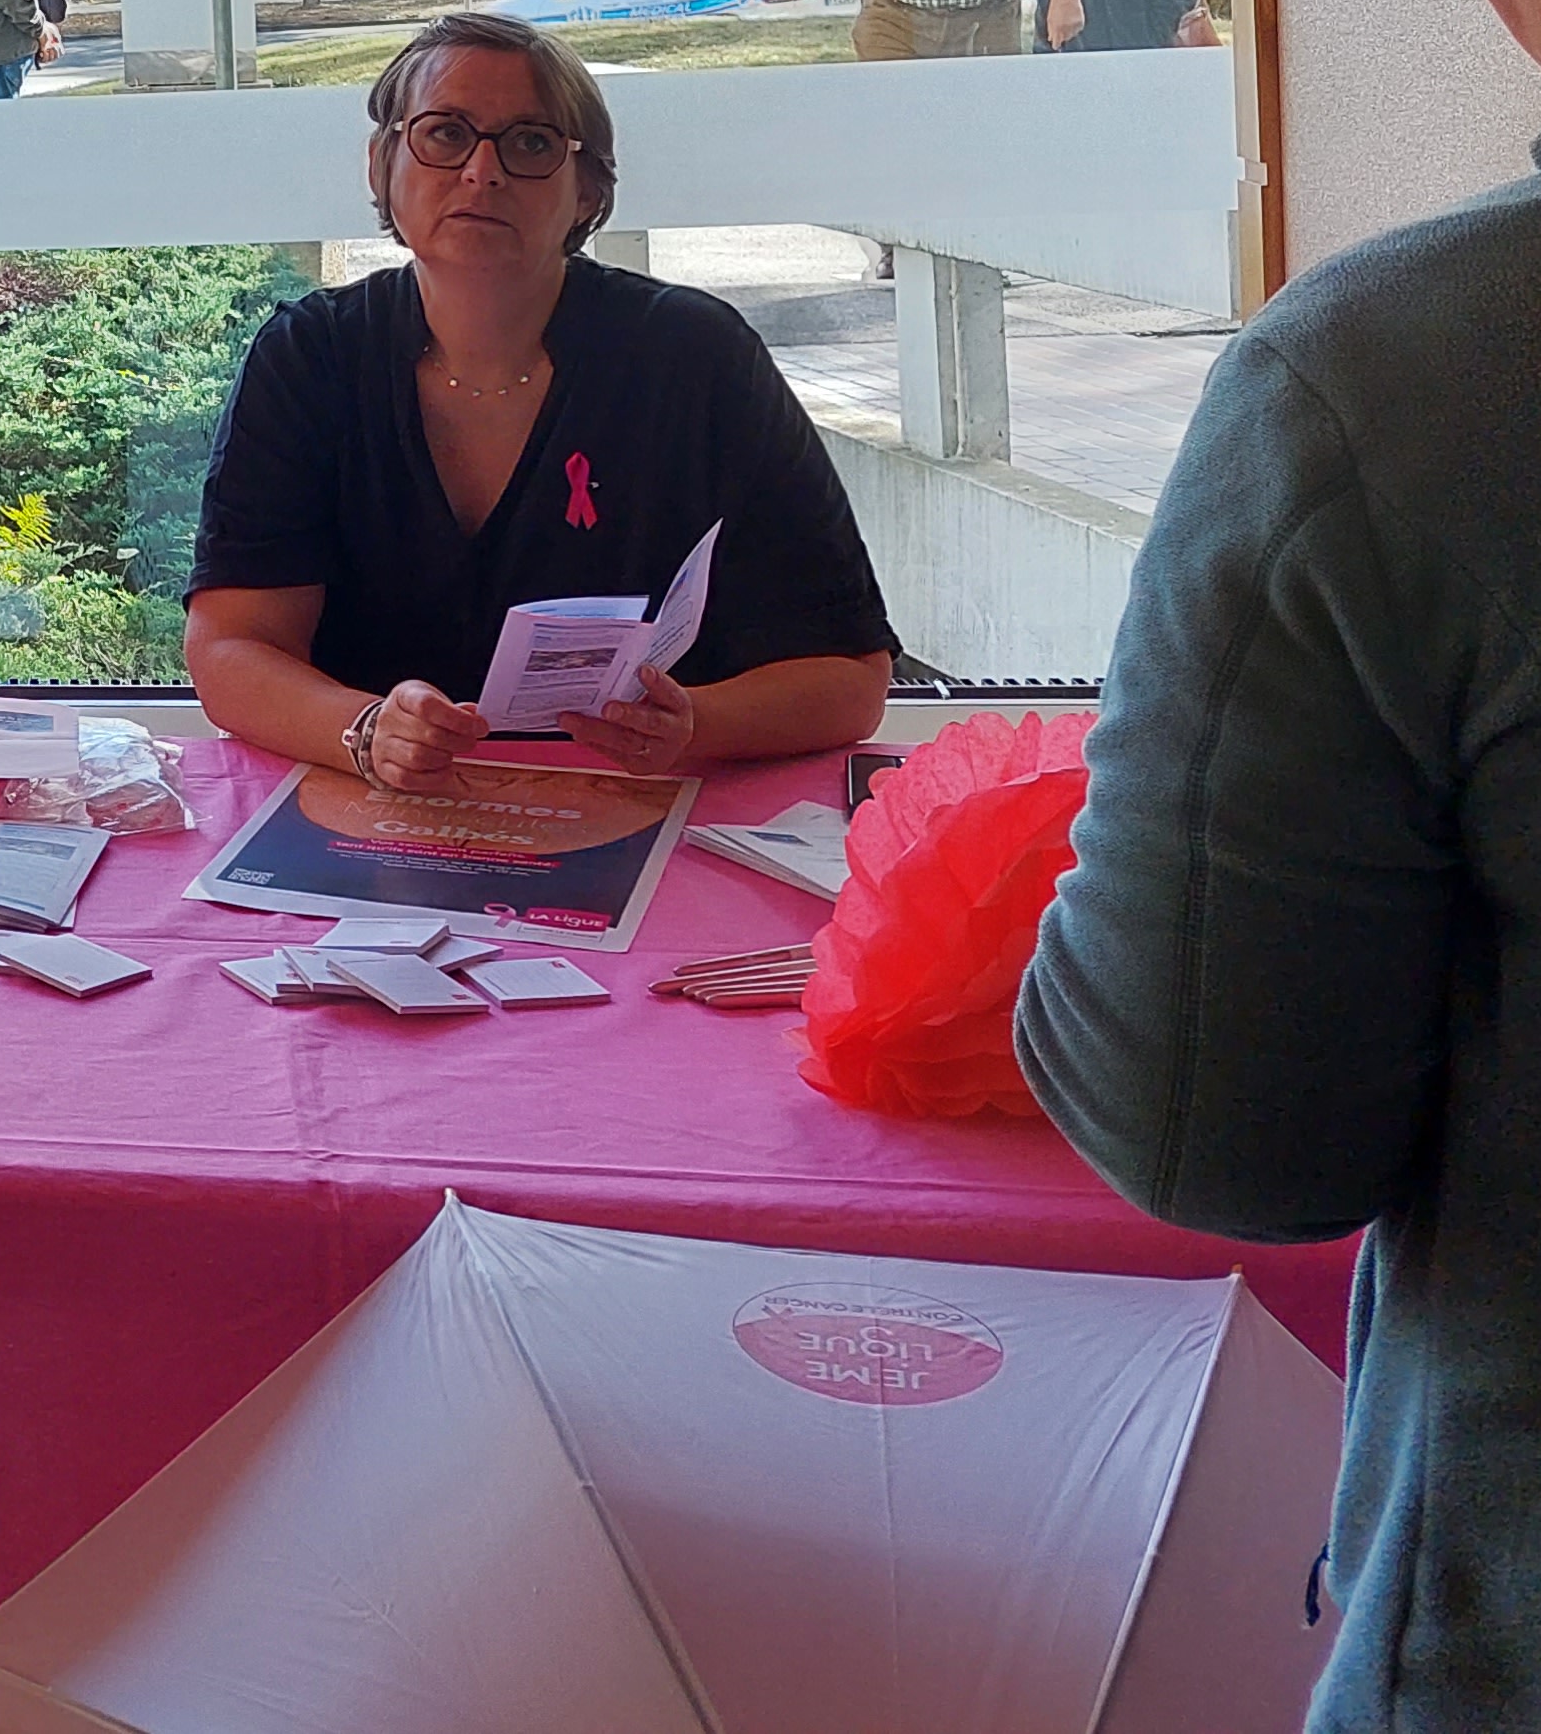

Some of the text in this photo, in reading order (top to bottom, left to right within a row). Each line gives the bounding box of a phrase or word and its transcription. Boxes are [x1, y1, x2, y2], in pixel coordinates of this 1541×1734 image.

[373, 820, 536, 846] Galbés
[764, 1295, 965, 1322] CONTRE LE CANCER
[805, 1359, 931, 1390] JE ME
